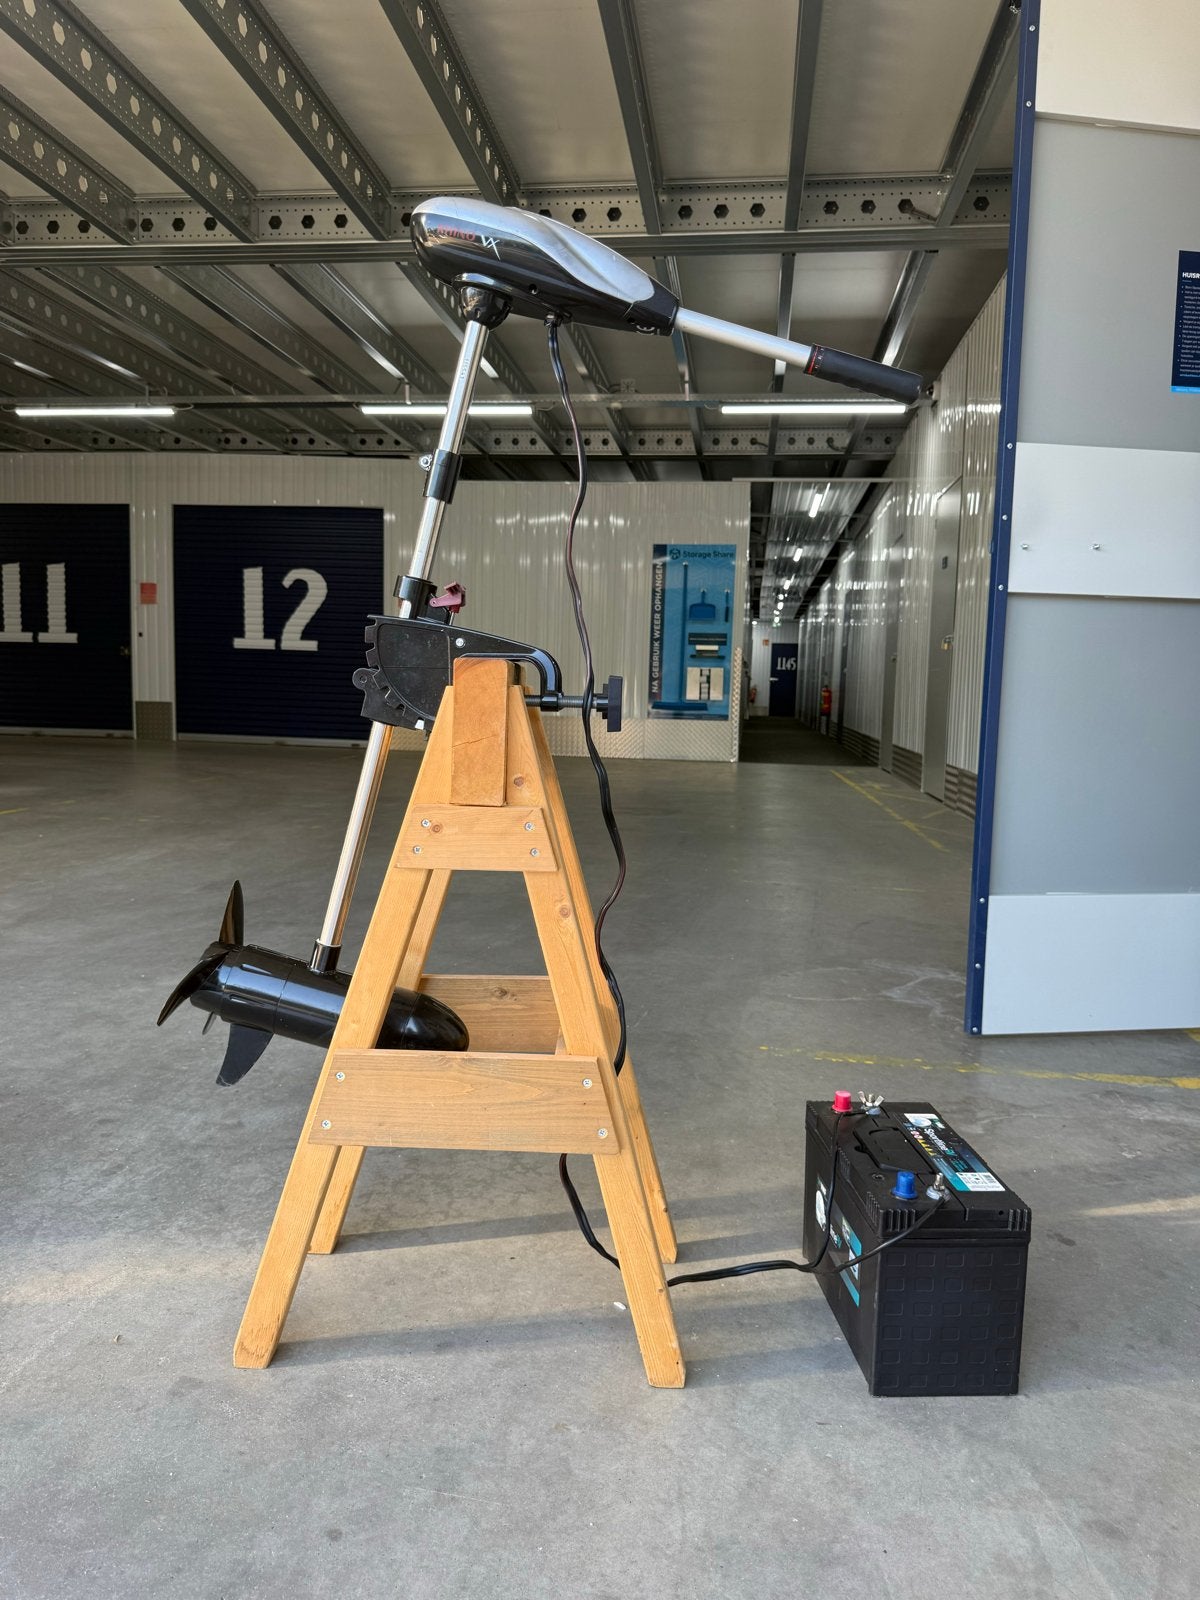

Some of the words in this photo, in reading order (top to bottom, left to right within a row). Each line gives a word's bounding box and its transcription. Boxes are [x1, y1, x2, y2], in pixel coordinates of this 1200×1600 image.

[480, 234, 500, 260] VX
[683, 550, 711, 559] Storage
[713, 550, 735, 558] Share
[654, 562, 663, 611] OPHANGEN
[0, 562, 78, 643] 11
[233, 566, 328, 651] 12
[653, 613, 661, 639] WEER
[652, 641, 660, 678] GEBRUIK
[776, 657, 796, 670] 1145
[651, 680, 658, 693] NA
